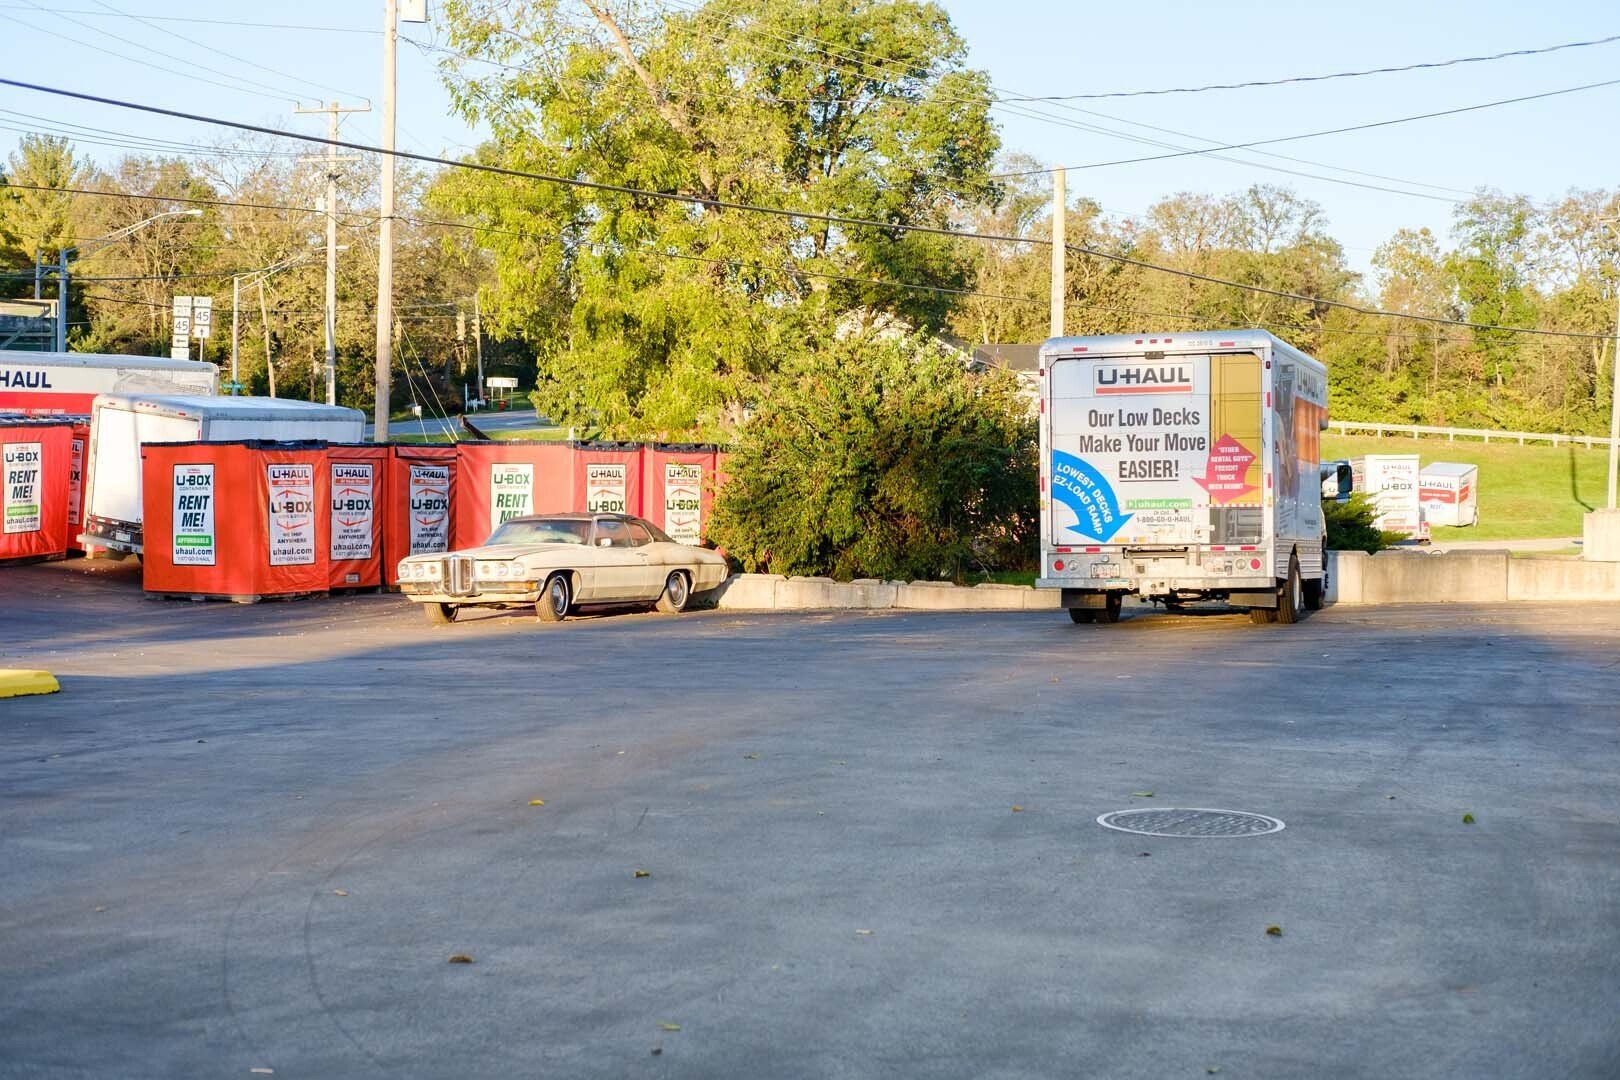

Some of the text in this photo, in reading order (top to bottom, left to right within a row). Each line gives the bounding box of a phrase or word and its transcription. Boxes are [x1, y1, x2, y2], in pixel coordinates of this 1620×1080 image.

[195, 311, 209, 322] 45
[175, 320, 189, 331] 45
[1098, 367, 1190, 385] U-HAUL
[1088, 408, 1200, 427] Our Low Decks
[1079, 433, 1206, 453] Make Your Move
[6, 451, 39, 462] U-BOX
[272, 469, 309, 478] U-HAUL
[335, 469, 369, 477] U-HAUL
[414, 470, 446, 478] U-HAUL
[590, 470, 622, 478] U-HAUL
[1118, 459, 1179, 479] EASIER!
[9, 470, 38, 484] RENT
[176, 475, 211, 486] U-BOX
[494, 473, 530, 484] U-BOX
[1419, 480, 1455, 489] U-HAUL
[12, 485, 33, 499] ME!
[1057, 463, 1113, 523] LOWEST DECKS
[178, 495, 210, 510] RENT
[333, 499, 372, 511] U-BOX
[411, 499, 448, 510] U-BOX
[496, 493, 529, 508] RENT
[588, 500, 624, 511] U-BOX
[1053, 474, 1103, 534] EZ-LOAD RAMP
[1137, 500, 1189, 508] uhaul.com
[271, 501, 312, 513] U-BOX
[7, 517, 38, 525] uhaul.com
[181, 512, 205, 527] ME!
[272, 547, 312, 556] uhaul.com
[333, 543, 370, 551] uhaul.com
